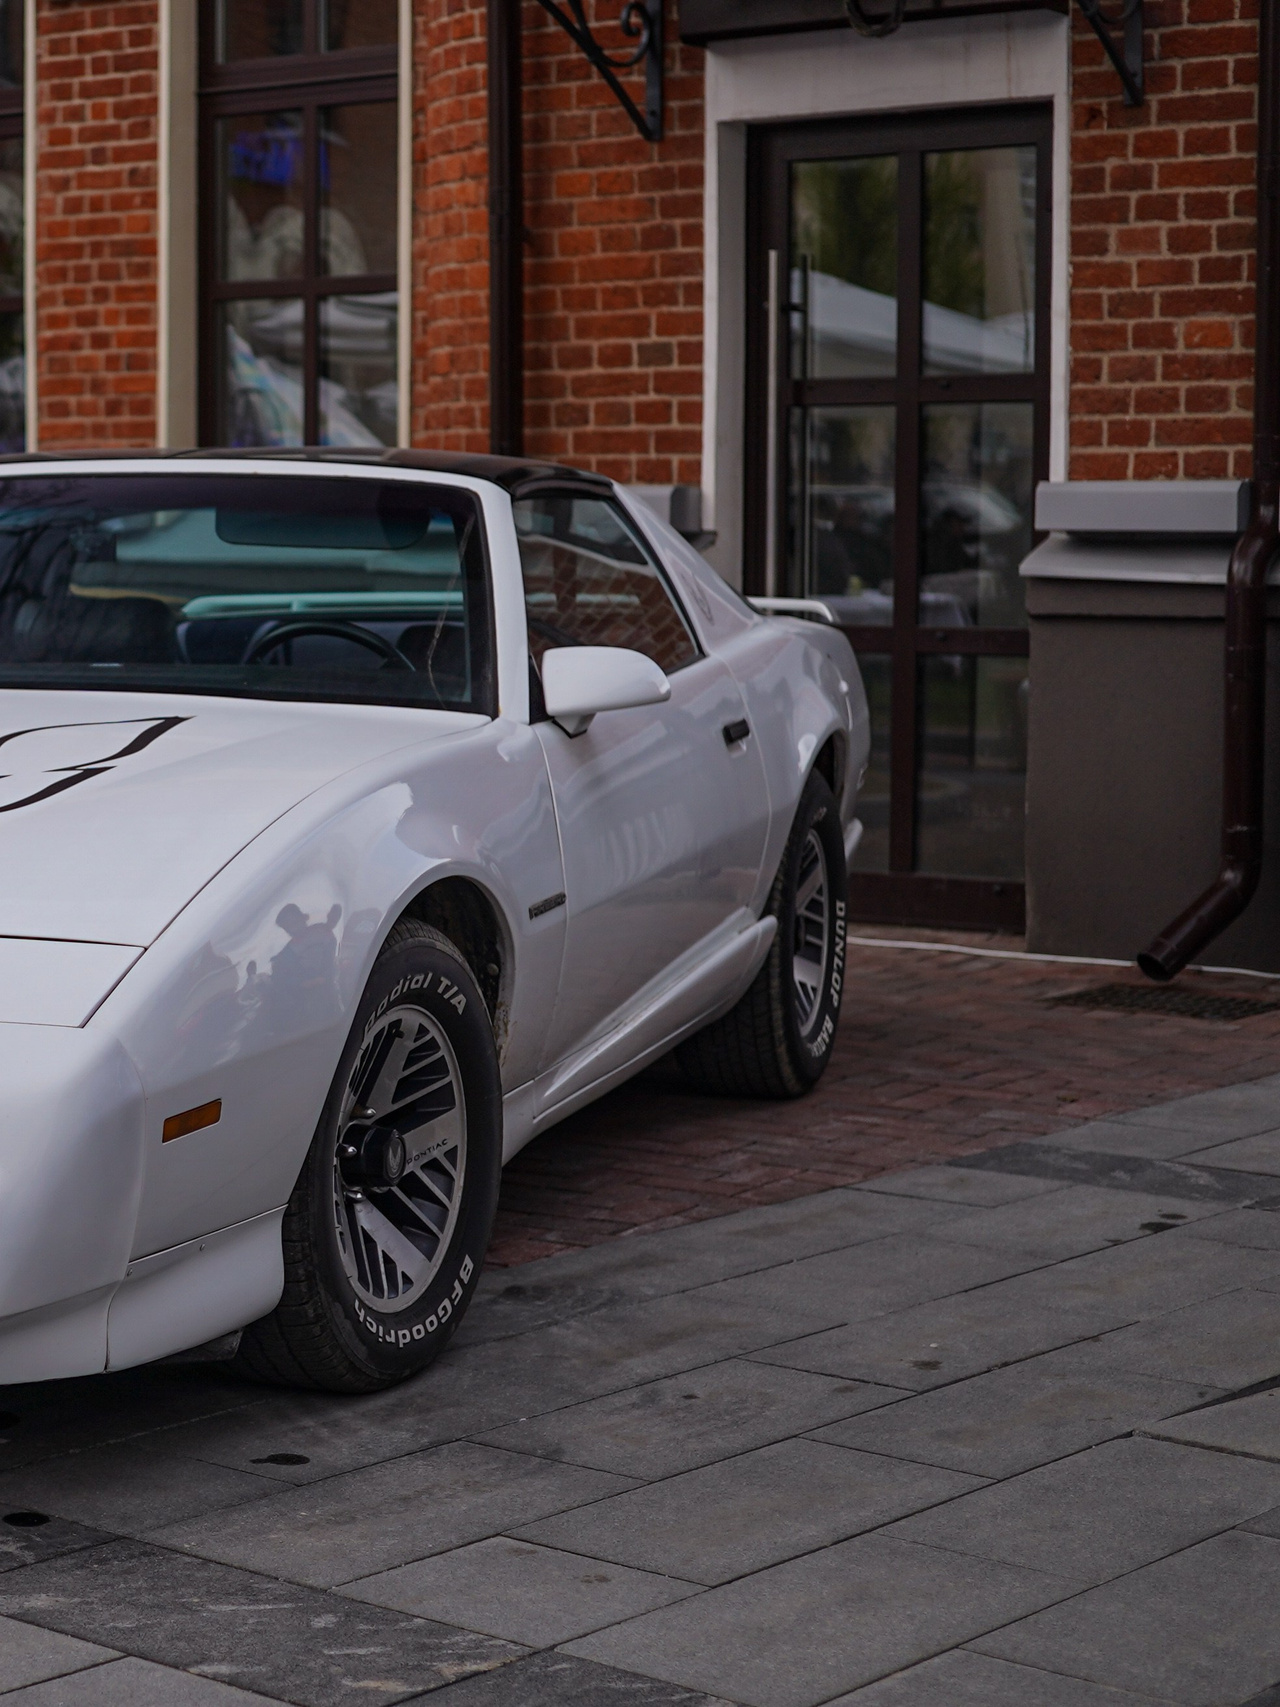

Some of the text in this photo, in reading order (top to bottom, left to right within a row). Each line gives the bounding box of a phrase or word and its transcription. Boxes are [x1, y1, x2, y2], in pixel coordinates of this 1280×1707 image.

[830, 899, 846, 1008] DUNLOP
[437, 976, 467, 1015] T/A
[407, 1138, 448, 1165] PONTIAC
[354, 1254, 474, 1348] BFGoodrich
